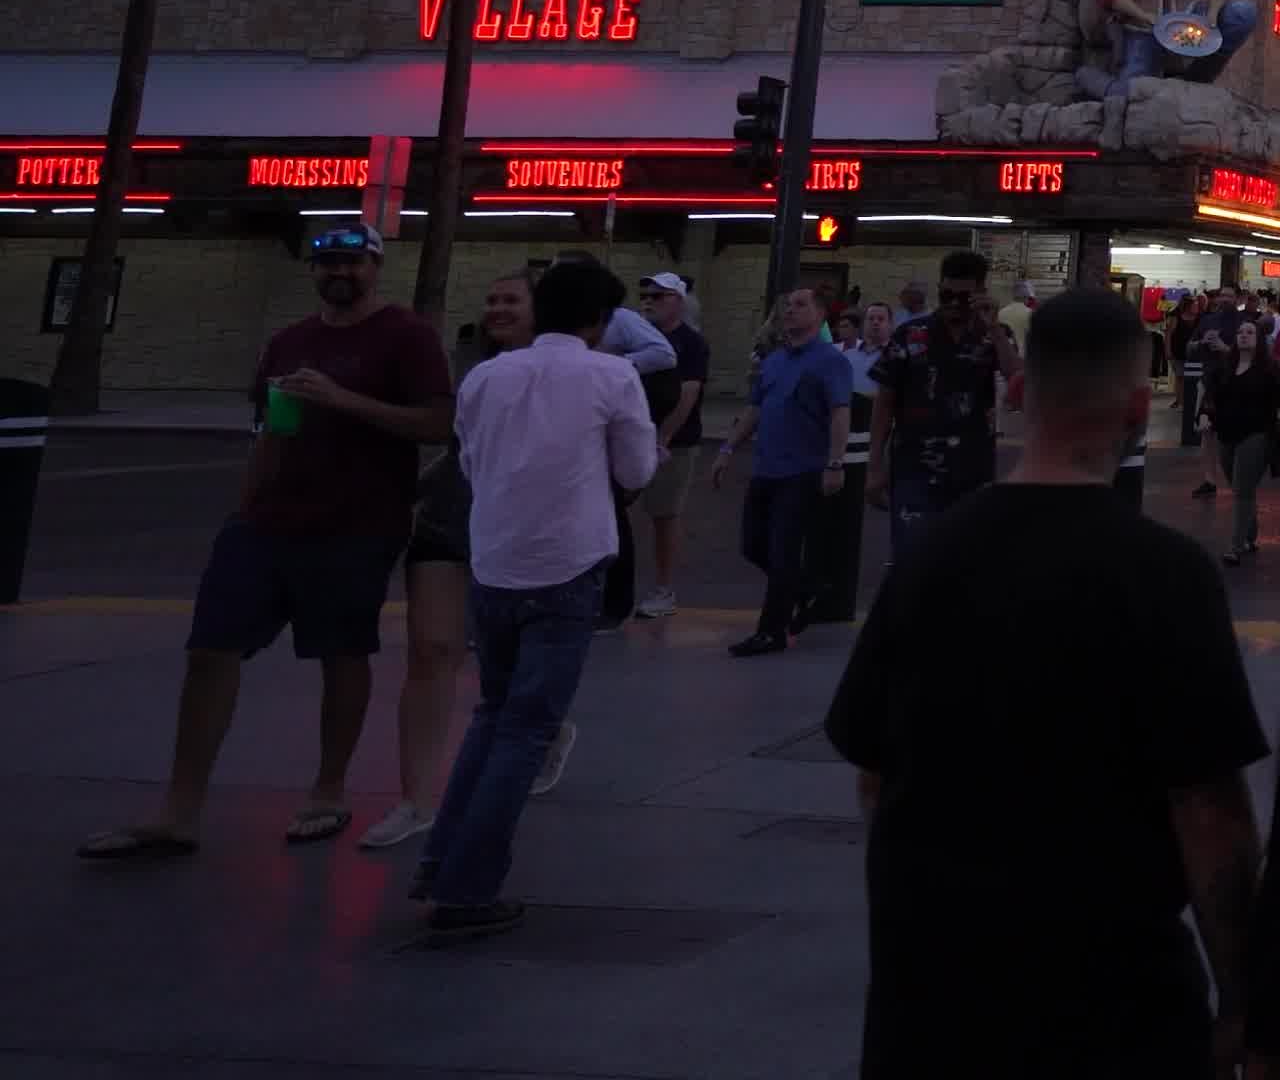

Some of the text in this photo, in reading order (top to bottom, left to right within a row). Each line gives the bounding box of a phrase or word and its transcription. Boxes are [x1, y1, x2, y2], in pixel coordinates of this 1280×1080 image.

[16, 157, 104, 187] POTTER
[249, 157, 369, 188] MOCASSINS
[507, 159, 623, 188] SOUVENIRS
[804, 160, 861, 191] IRTS
[1001, 161, 1064, 192] GIFTS
